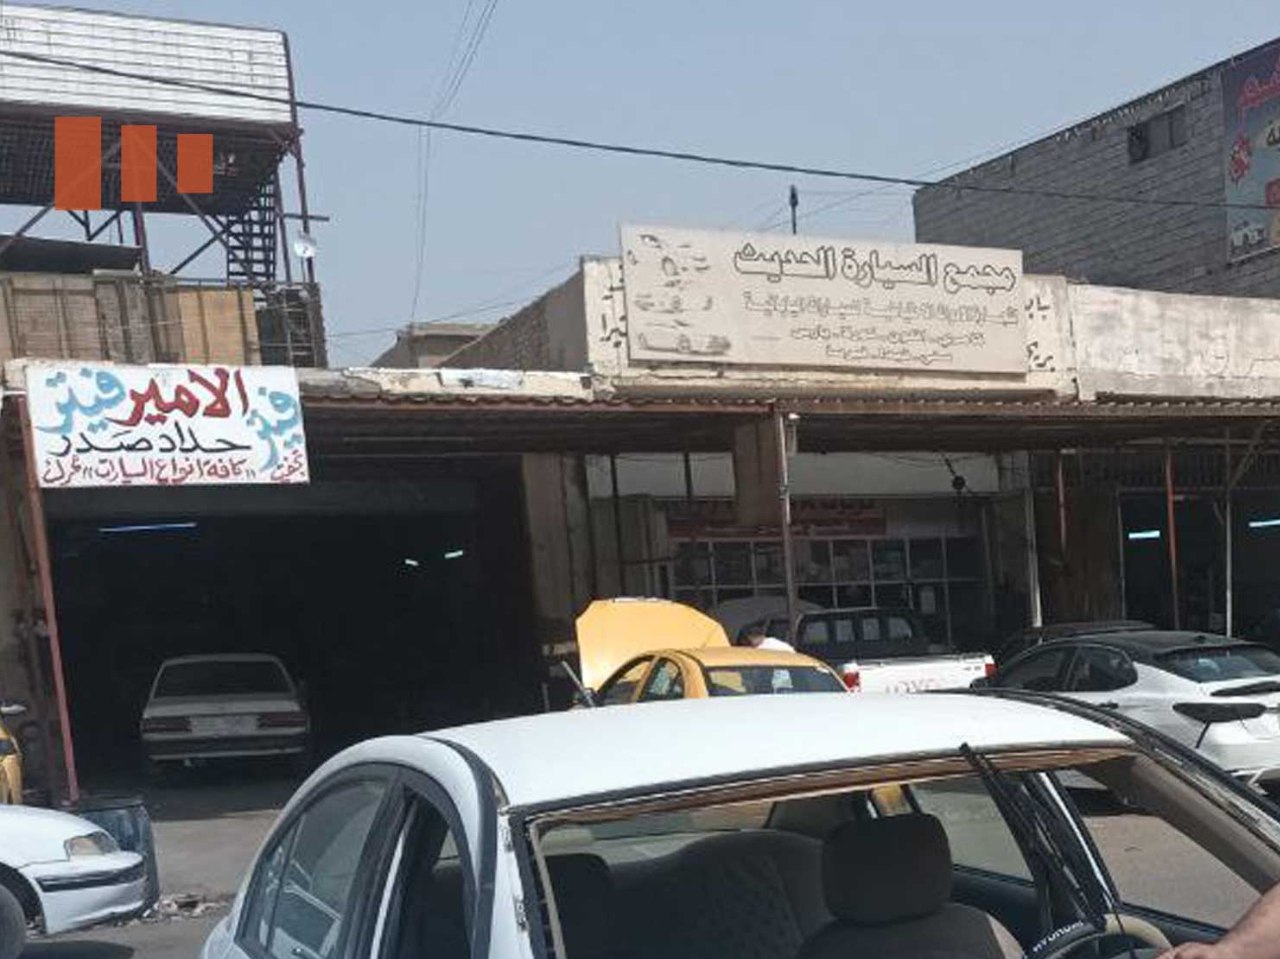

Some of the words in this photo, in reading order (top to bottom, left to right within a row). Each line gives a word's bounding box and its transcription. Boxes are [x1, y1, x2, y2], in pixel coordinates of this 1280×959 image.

[841, 249, 938, 289] السيارة
[942, 261, 1017, 295] مجمع
[104, 367, 249, 427] الامير
